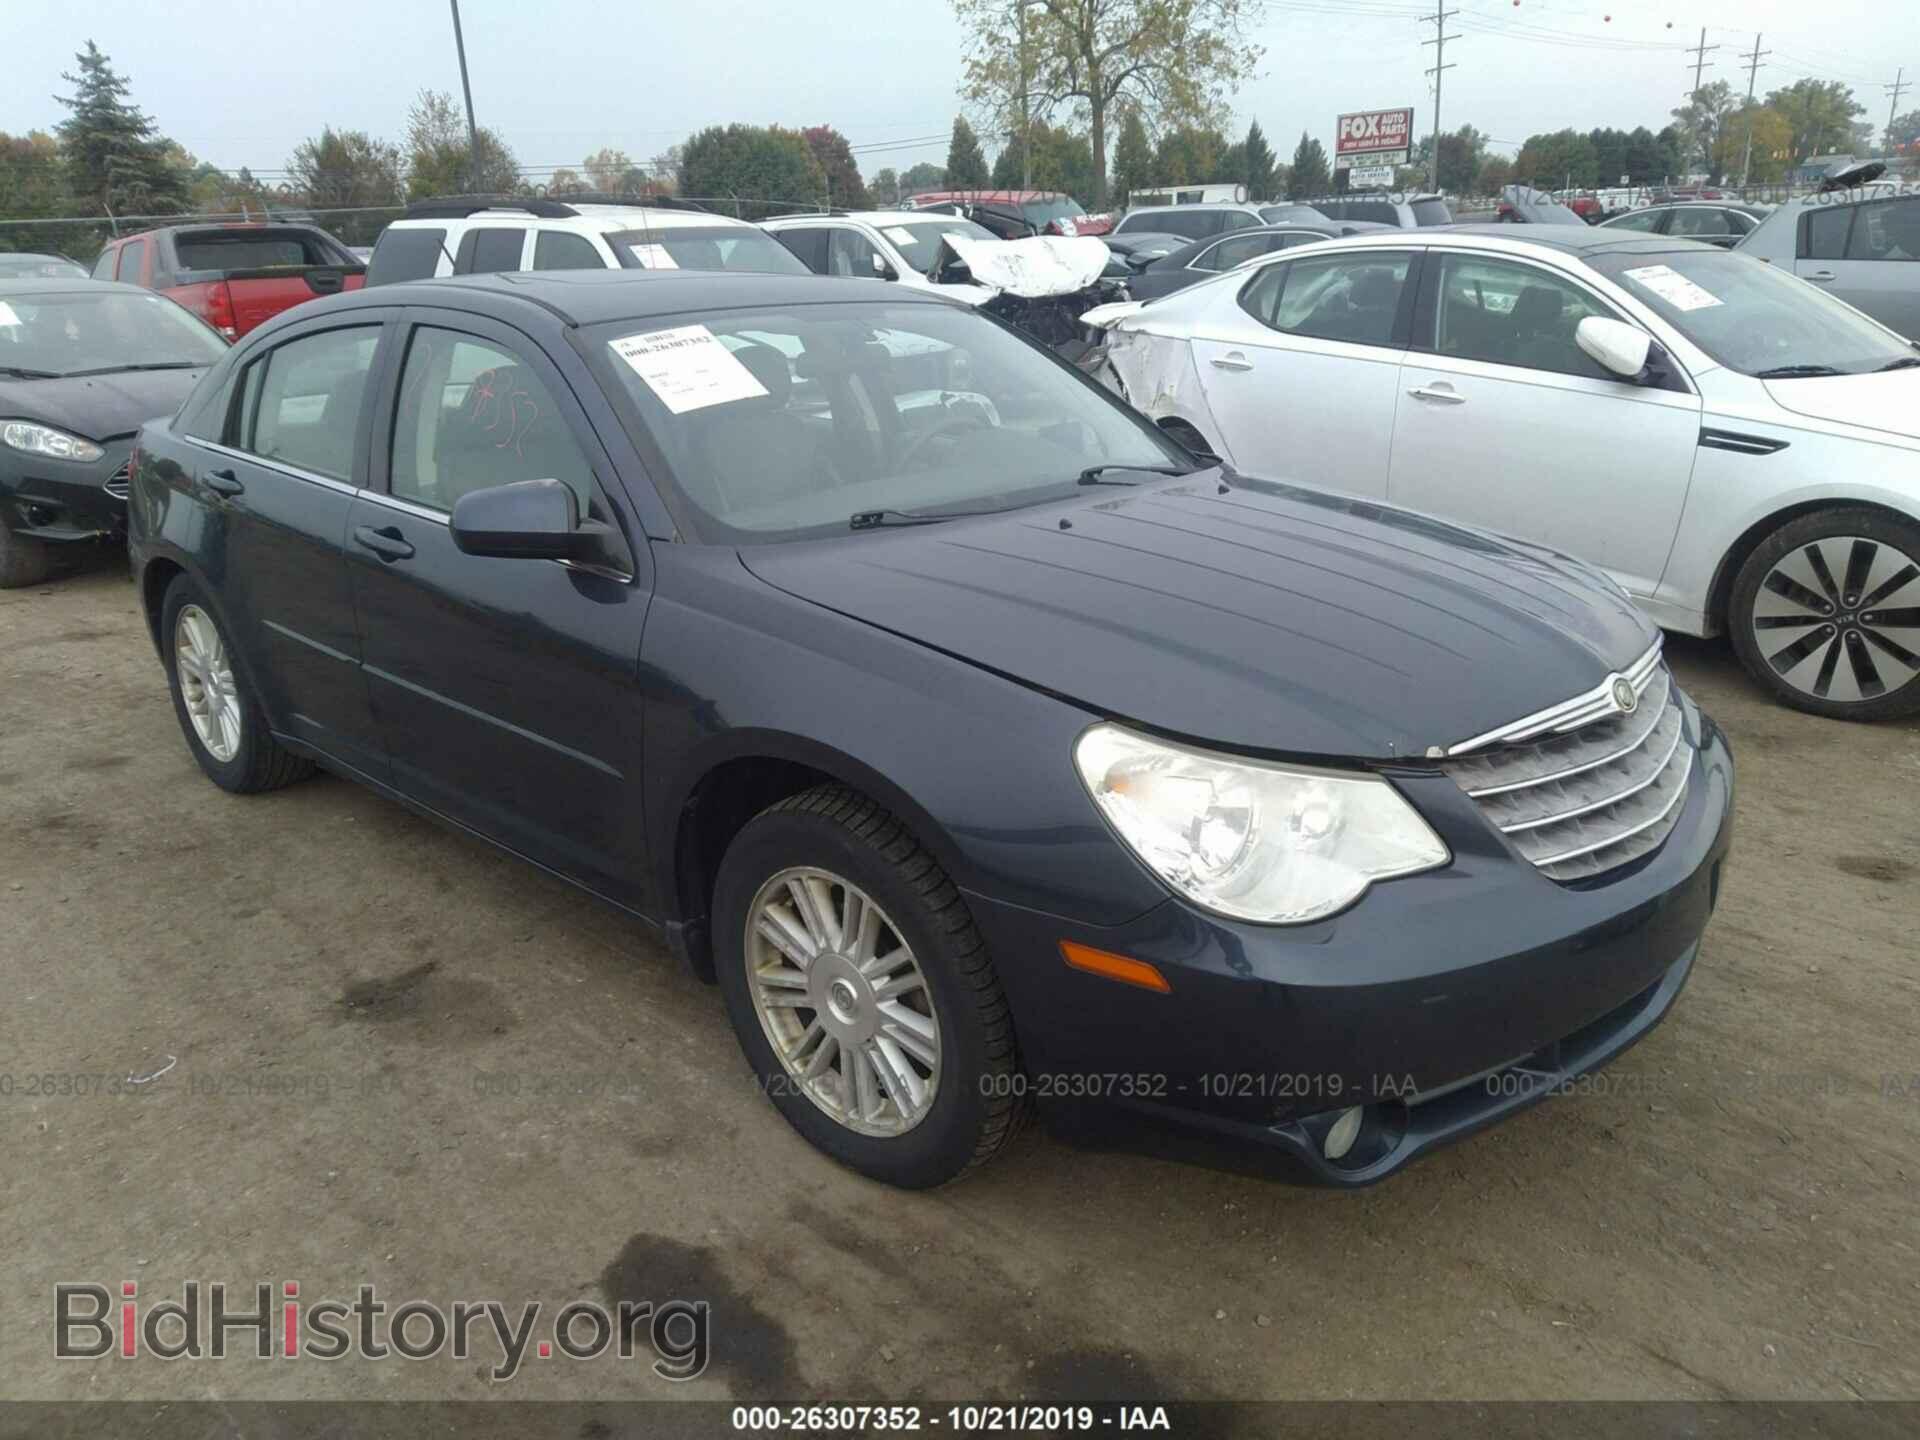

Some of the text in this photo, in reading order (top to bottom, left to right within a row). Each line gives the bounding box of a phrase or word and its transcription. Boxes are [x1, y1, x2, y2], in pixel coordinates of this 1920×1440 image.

[1382, 112, 1404, 124] AUTO
[1340, 115, 1380, 139] FOX
[1381, 122, 1406, 135] PARTS
